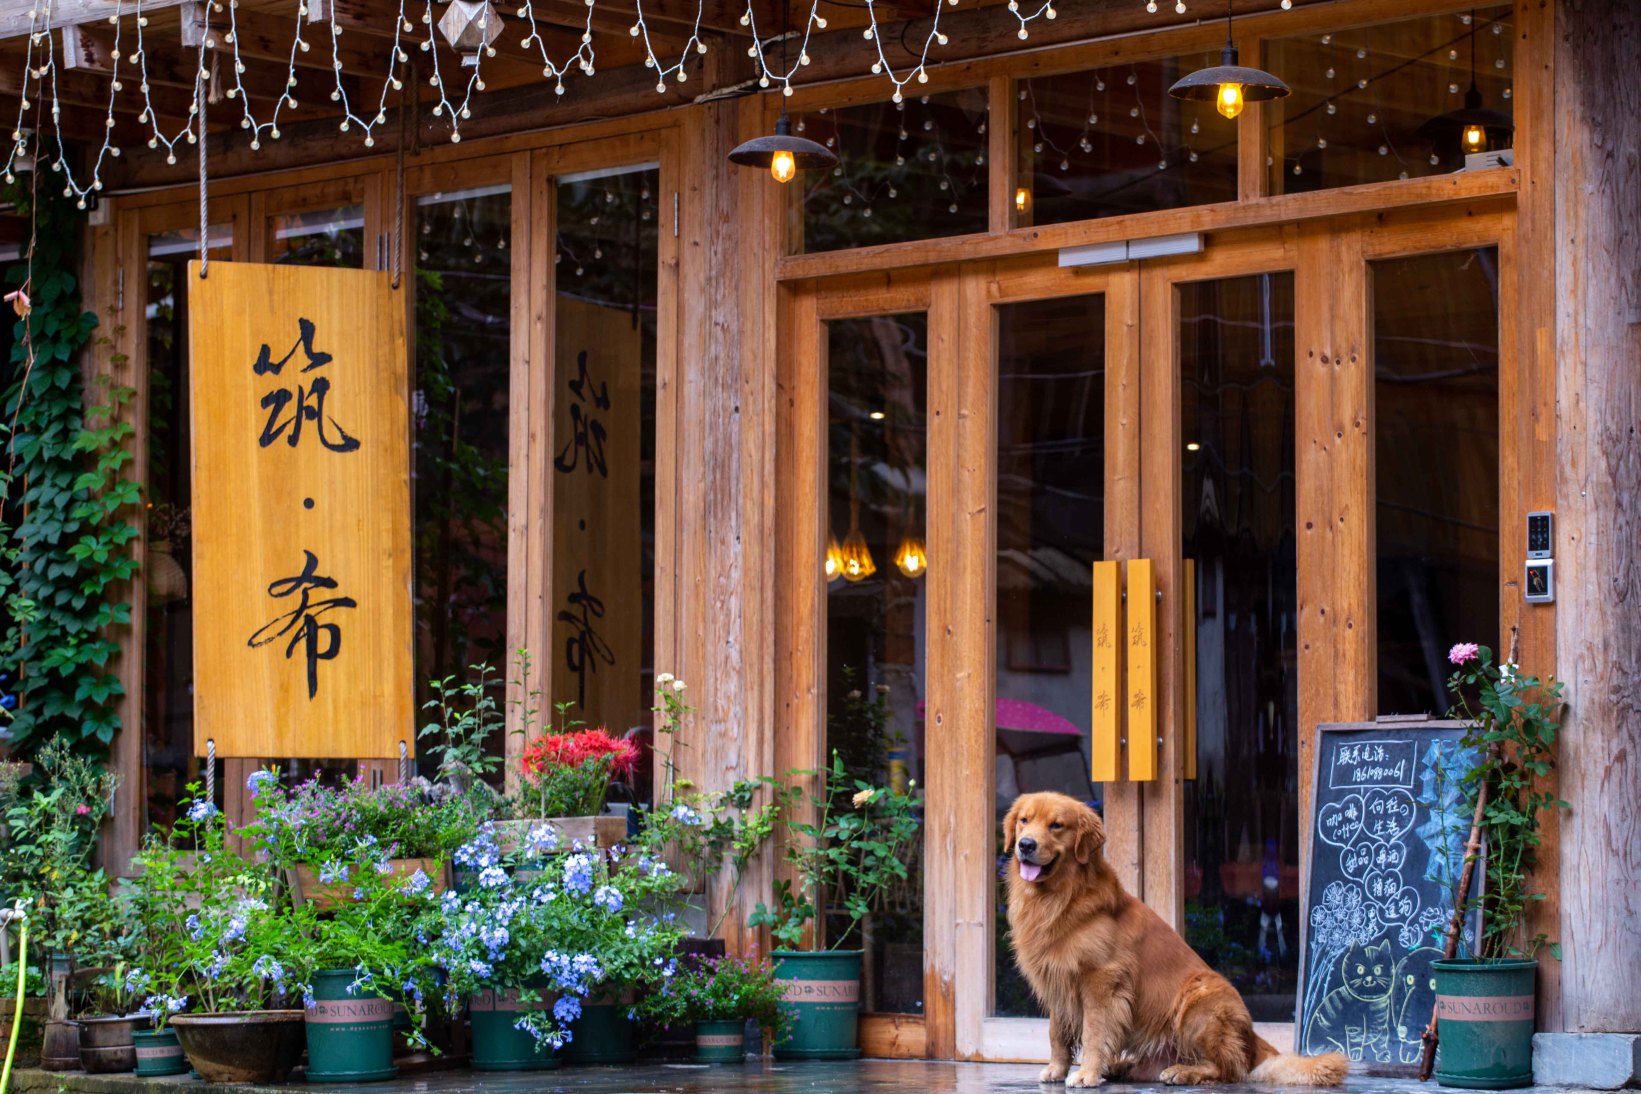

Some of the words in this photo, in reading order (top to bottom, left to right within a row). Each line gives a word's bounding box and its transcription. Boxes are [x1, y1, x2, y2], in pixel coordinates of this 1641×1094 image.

[1326, 803, 1358, 826] 咖啡
[1373, 816, 1400, 837] 生活
[1345, 847, 1369, 873] 甜品
[1376, 847, 1399, 870] 啤酒
[1448, 1001, 1521, 1015] SUNAROUD
